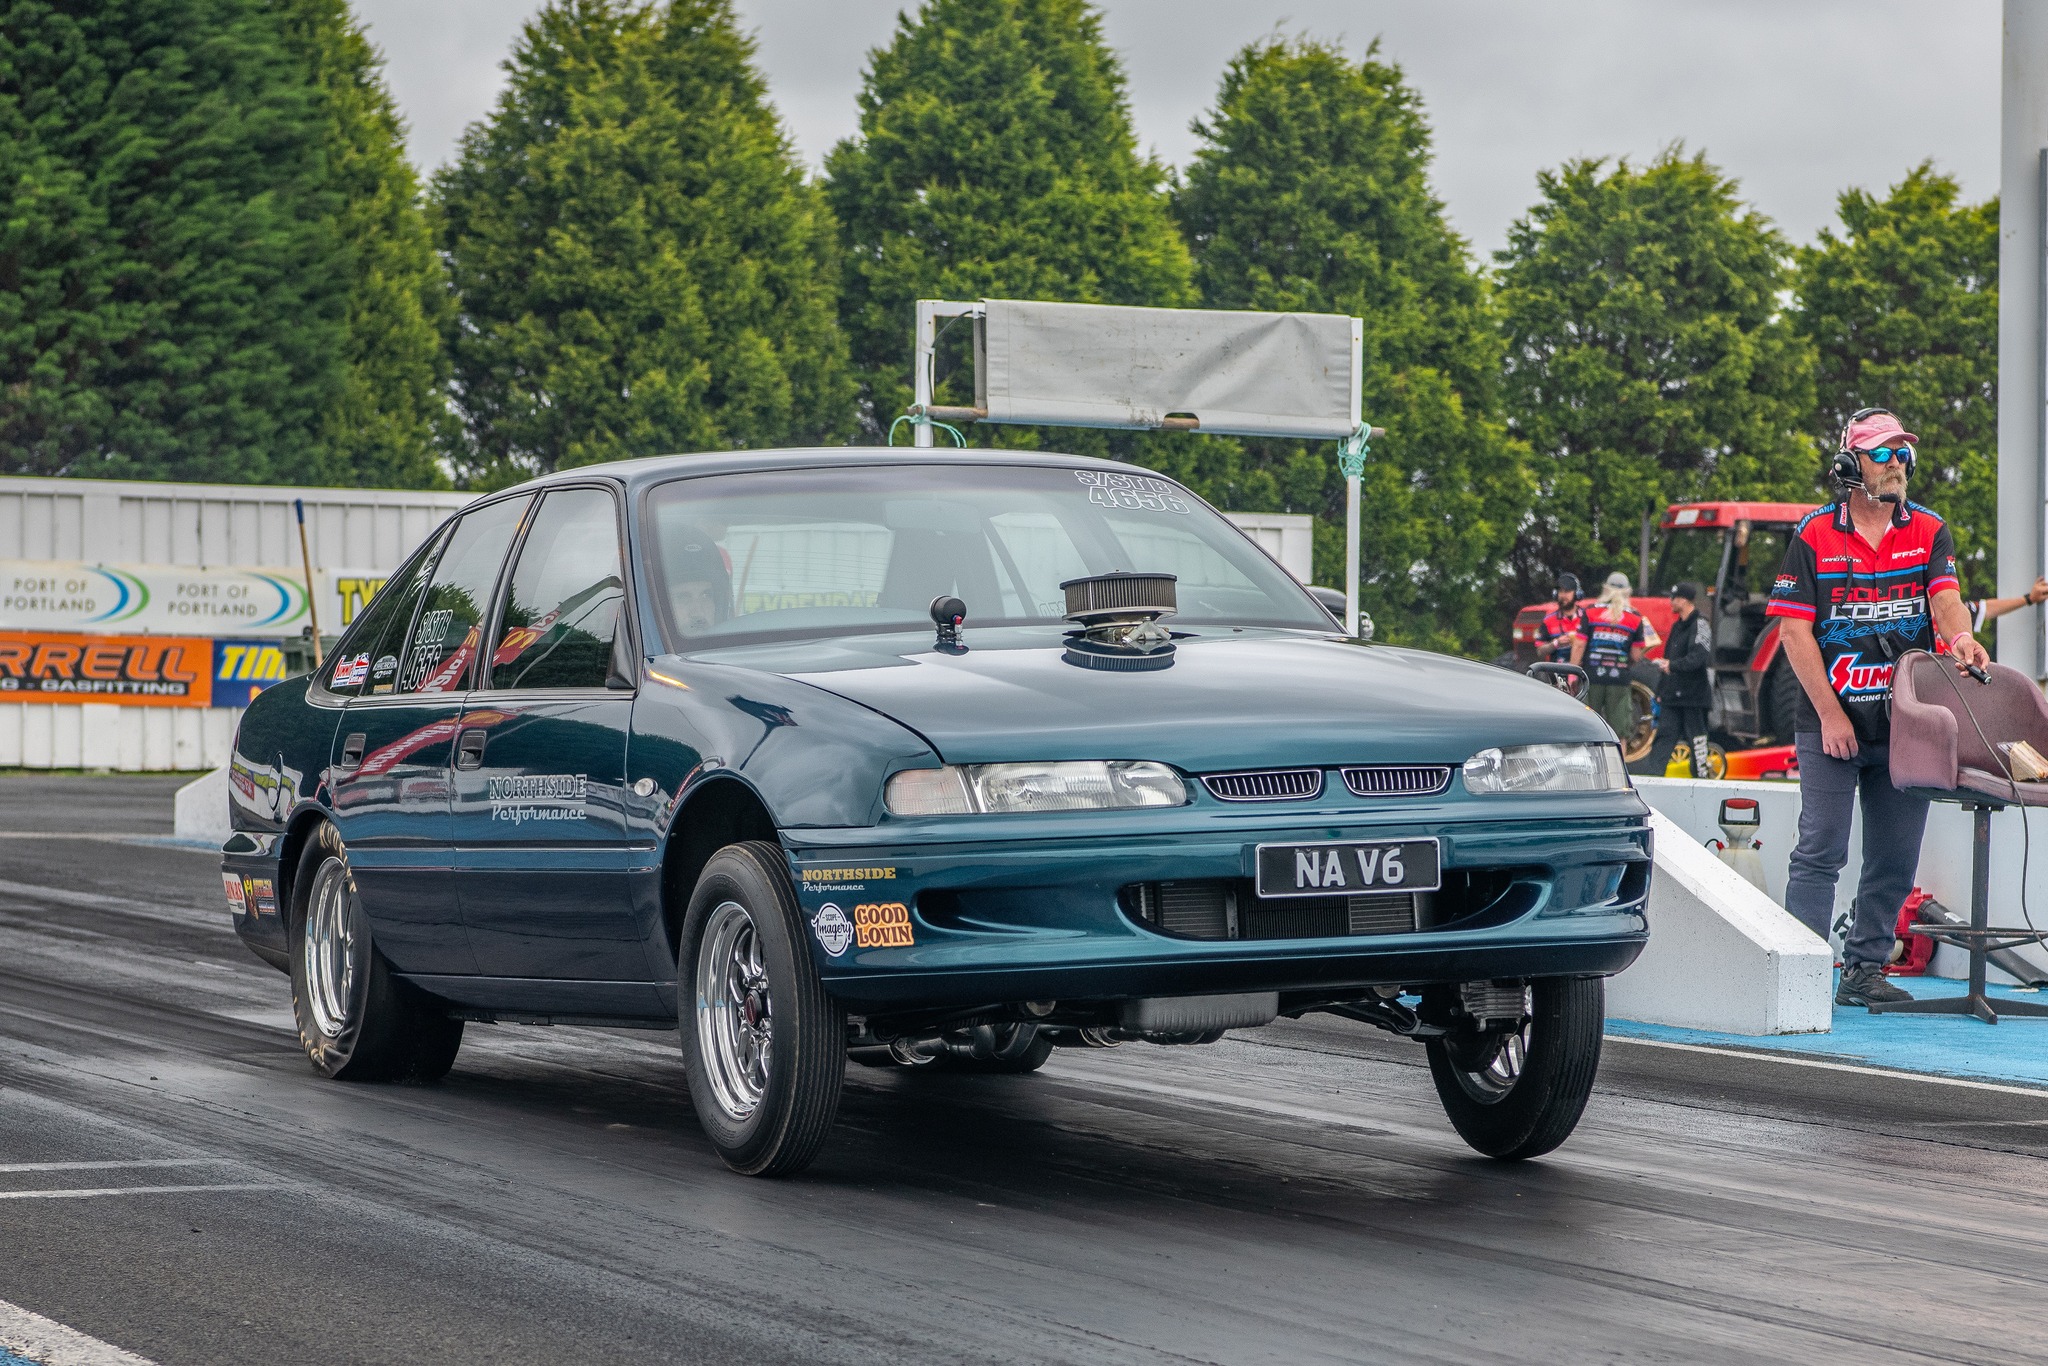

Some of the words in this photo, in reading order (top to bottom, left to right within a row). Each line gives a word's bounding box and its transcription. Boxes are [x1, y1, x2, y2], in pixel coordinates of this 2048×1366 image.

[1089, 486, 1190, 514] 4656
[1797, 503, 1836, 533] PORTLAND
[14, 578, 56, 593] PORT
[65, 580, 87, 594] OF
[177, 583, 219, 598] PORT
[227, 585, 250, 599] OF
[1831, 582, 1925, 603] SOUTH
[4, 596, 96, 613] PORTLAND
[168, 601, 258, 617] PORTLAND
[338, 577, 388, 626] TY
[1830, 598, 1926, 620] COAST
[401, 644, 443, 690] 4656
[41, 679, 186, 695] GASFITTING
[1849, 694, 1881, 703] RACING
[490, 774, 587, 799] NORTHSIDE
[491, 802, 587, 826] Performance
[802, 868, 896, 881] NORTHSIDE
[1297, 851, 1346, 888] NA
[1357, 848, 1404, 885] V6
[802, 881, 865, 893] Performance
[856, 906, 907, 925] GOOD
[812, 918, 852, 941] Imagery
[858, 925, 911, 944] LOVIN
